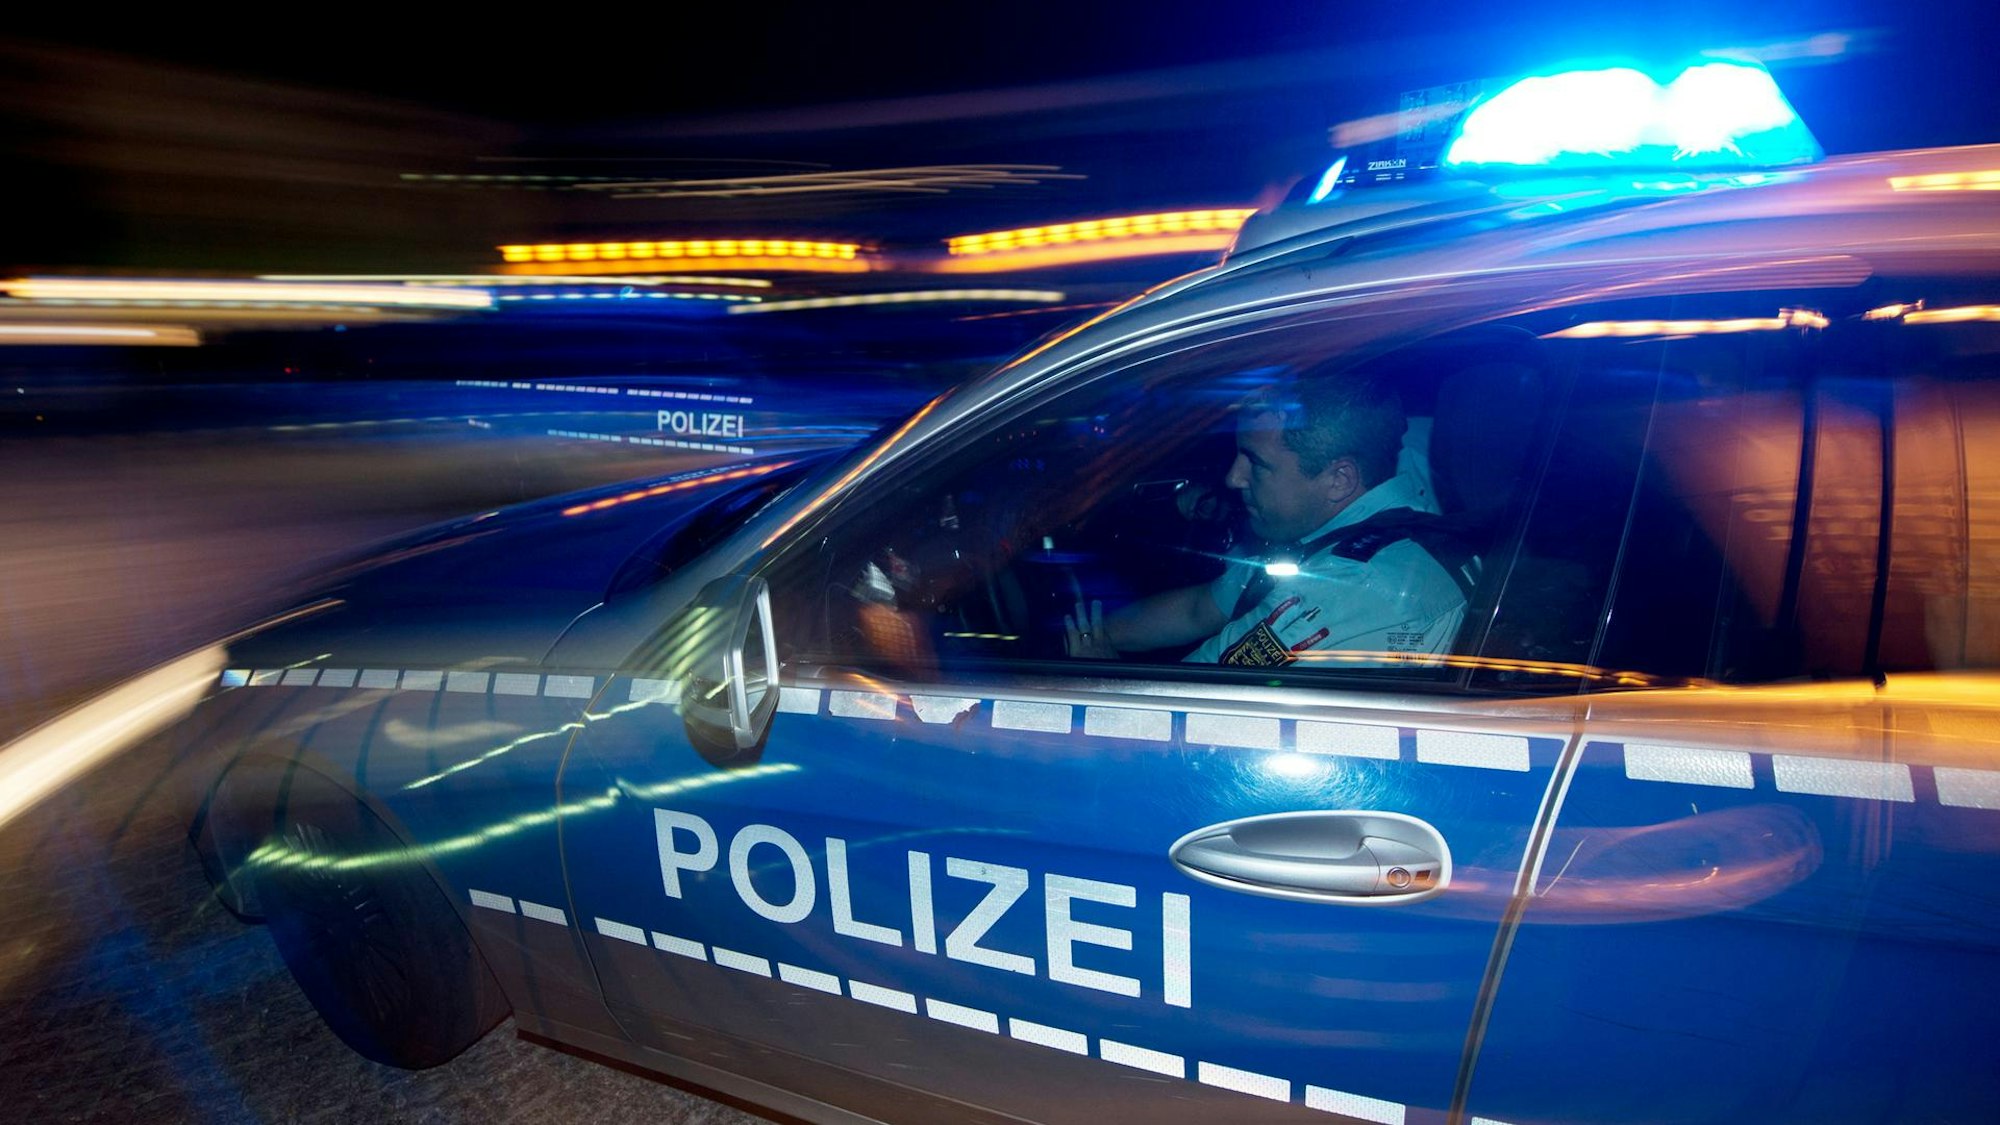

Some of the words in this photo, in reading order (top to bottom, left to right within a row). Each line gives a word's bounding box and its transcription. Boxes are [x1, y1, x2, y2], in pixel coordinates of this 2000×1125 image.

[657, 410, 743, 438] POLIZEI
[1257, 630, 1283, 662] POLIZEI
[653, 807, 1192, 1008] POLIZEI
